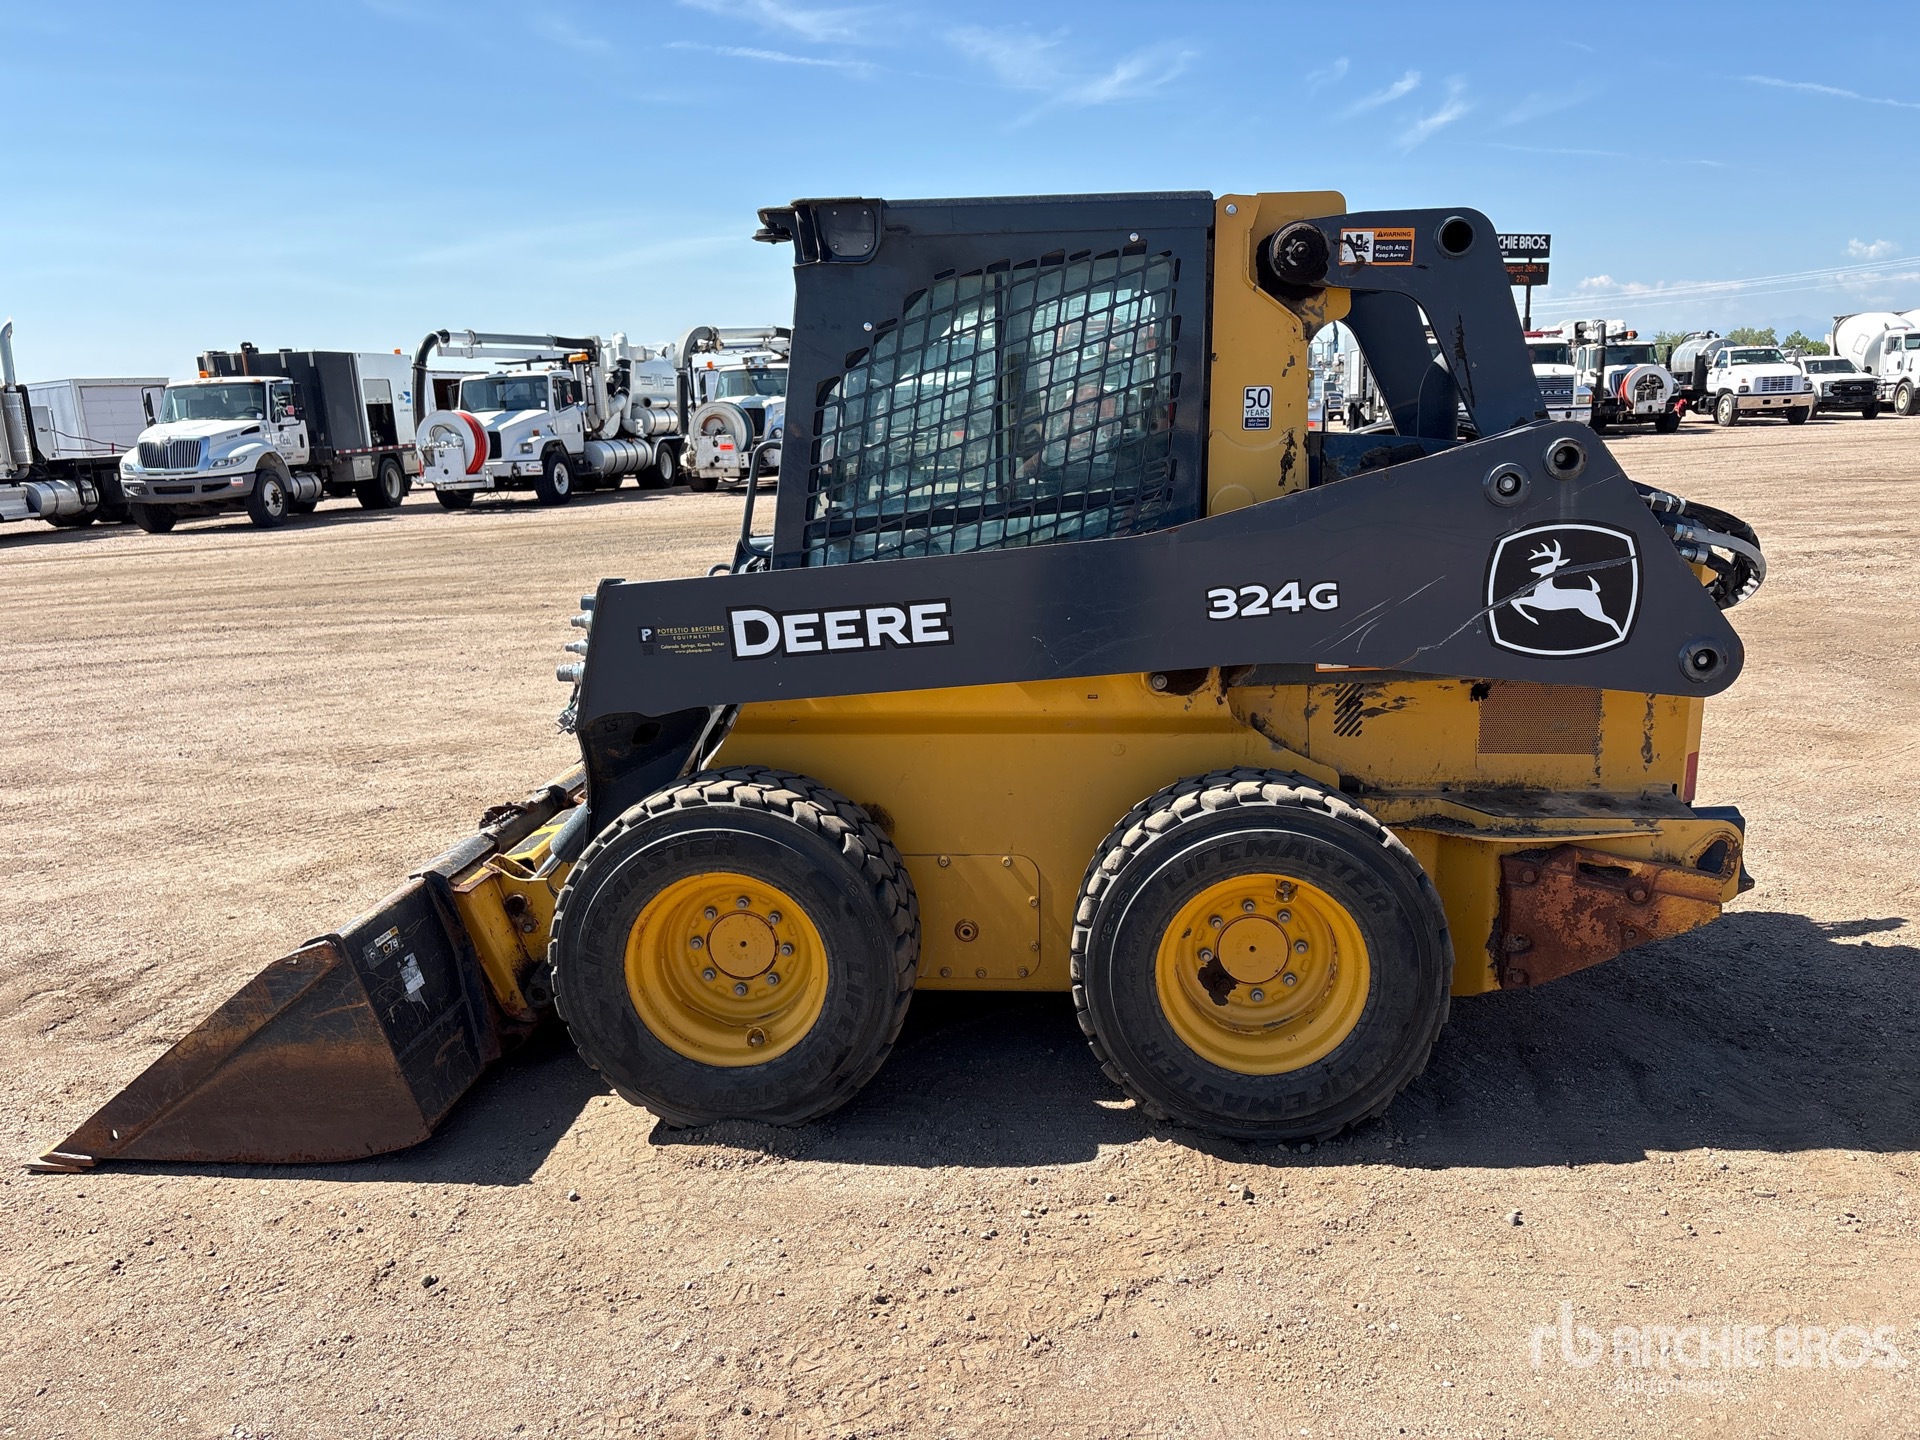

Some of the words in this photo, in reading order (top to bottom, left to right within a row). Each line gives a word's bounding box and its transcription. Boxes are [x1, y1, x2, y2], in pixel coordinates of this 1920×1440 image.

[1497, 235, 1519, 250] CHIE
[1519, 235, 1549, 250] BROS.
[1245, 388, 1271, 409] 50
[1245, 409, 1270, 417] YEARS
[1207, 581, 1339, 619] 324G
[691, 625, 725, 633] BROTHERS
[731, 602, 949, 657] DEERE
[1161, 838, 1392, 915] LIFEMASTER
